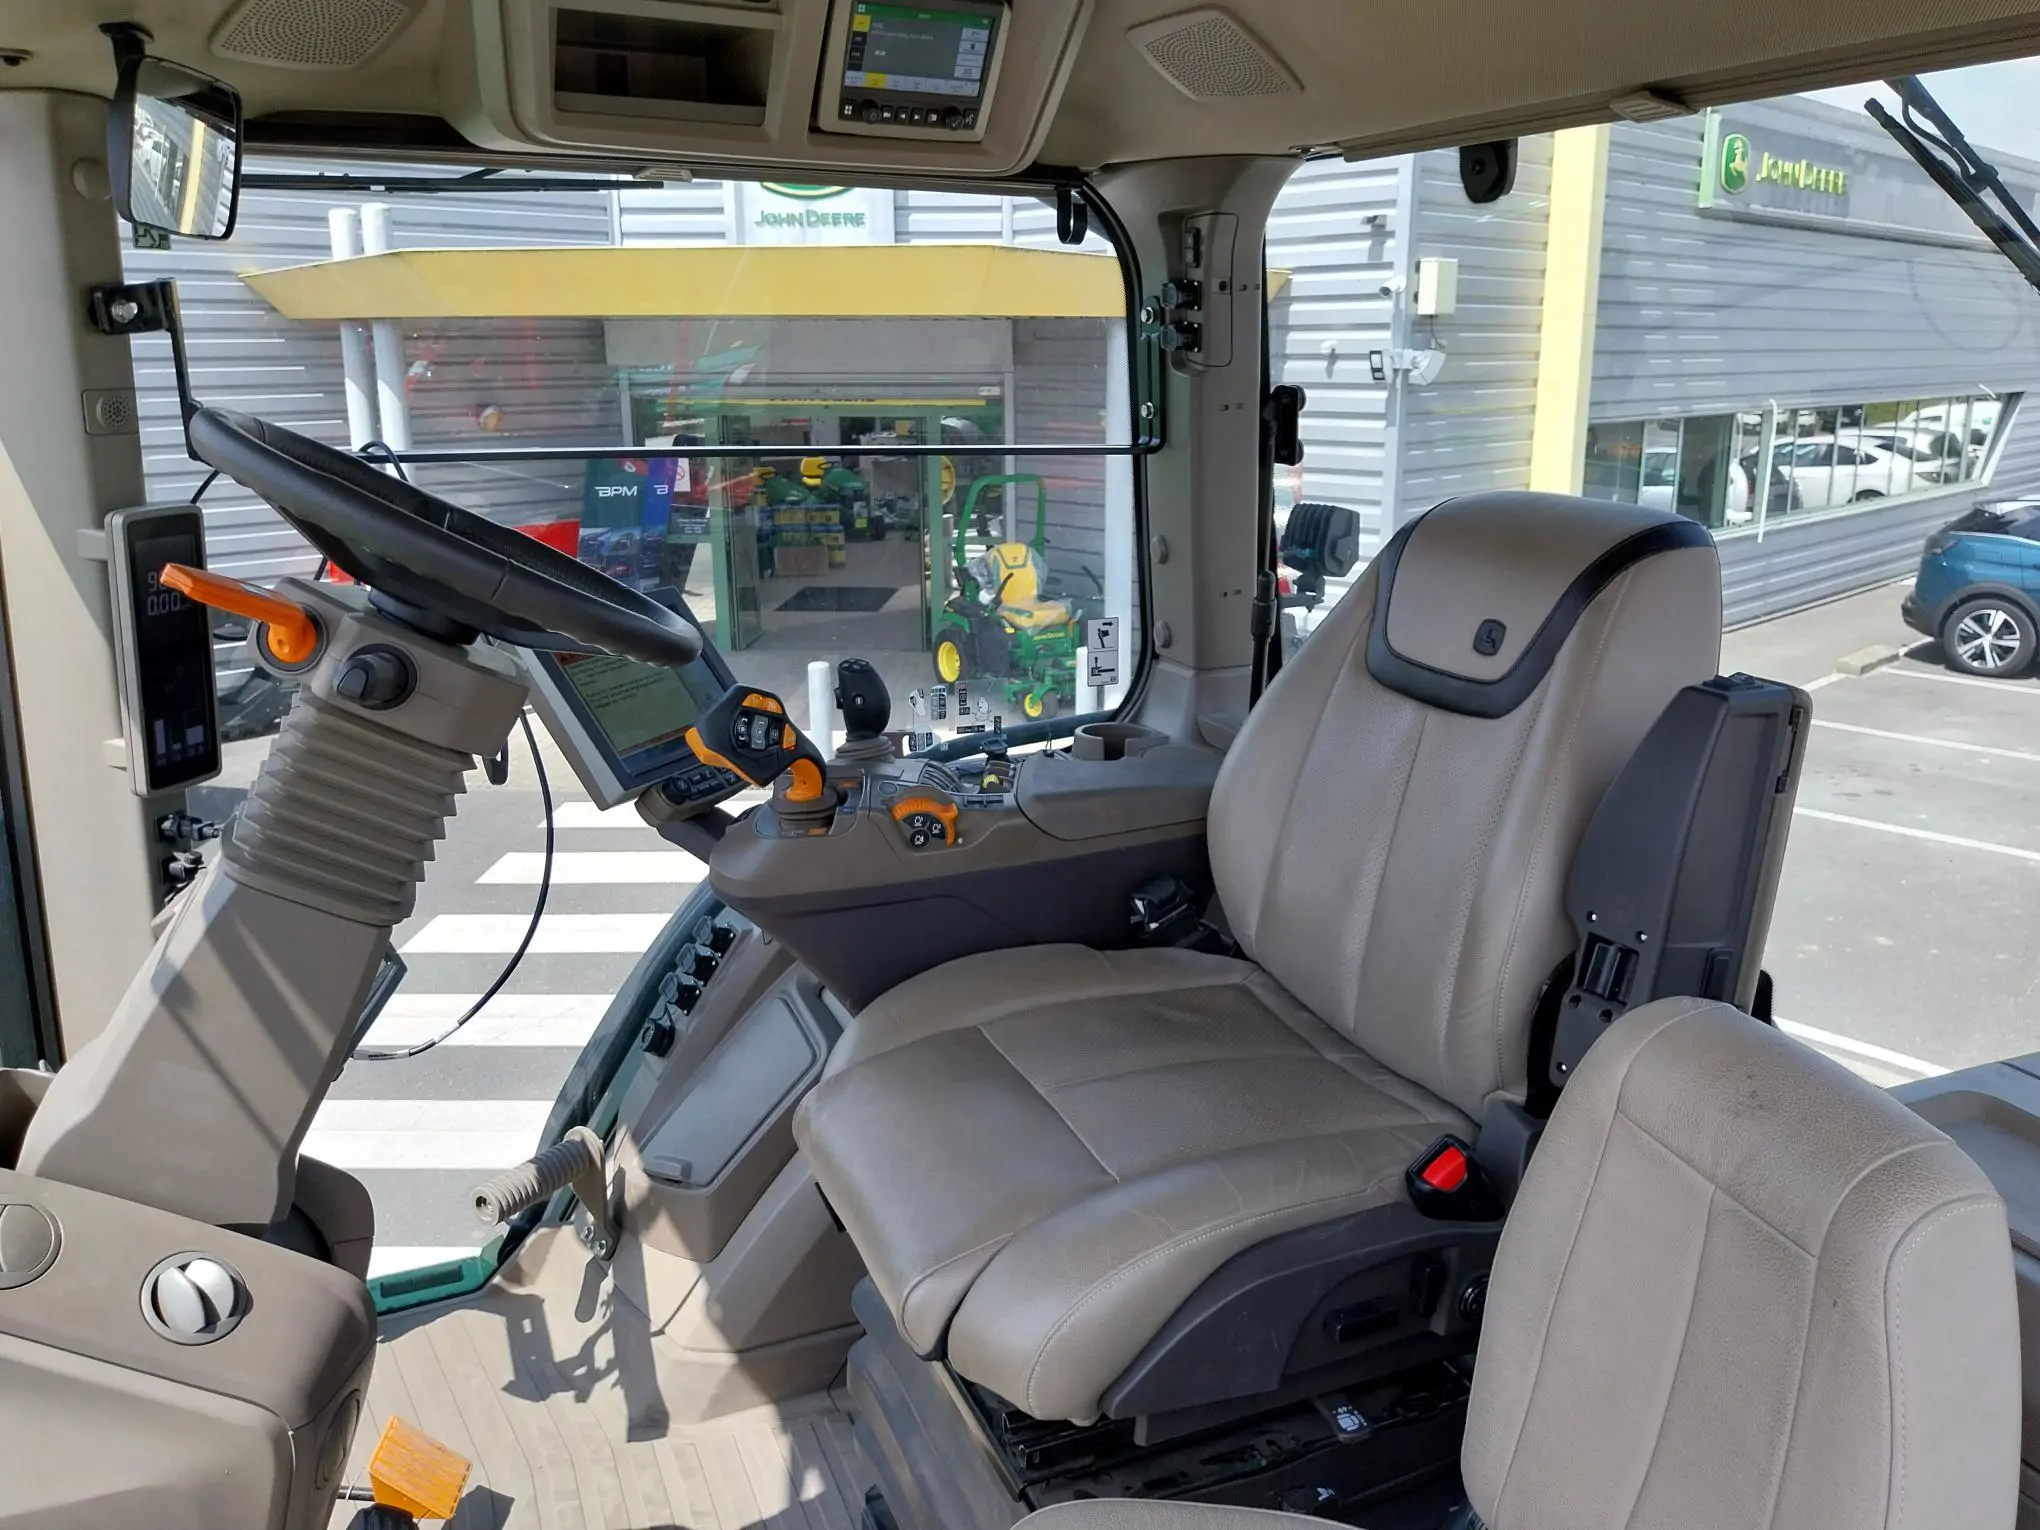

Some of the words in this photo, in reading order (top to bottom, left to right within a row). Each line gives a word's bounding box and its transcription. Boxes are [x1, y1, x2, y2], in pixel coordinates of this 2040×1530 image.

[754, 210, 803, 229] JOHN
[805, 208, 866, 228] DEERE
[594, 485, 638, 497] BPM
